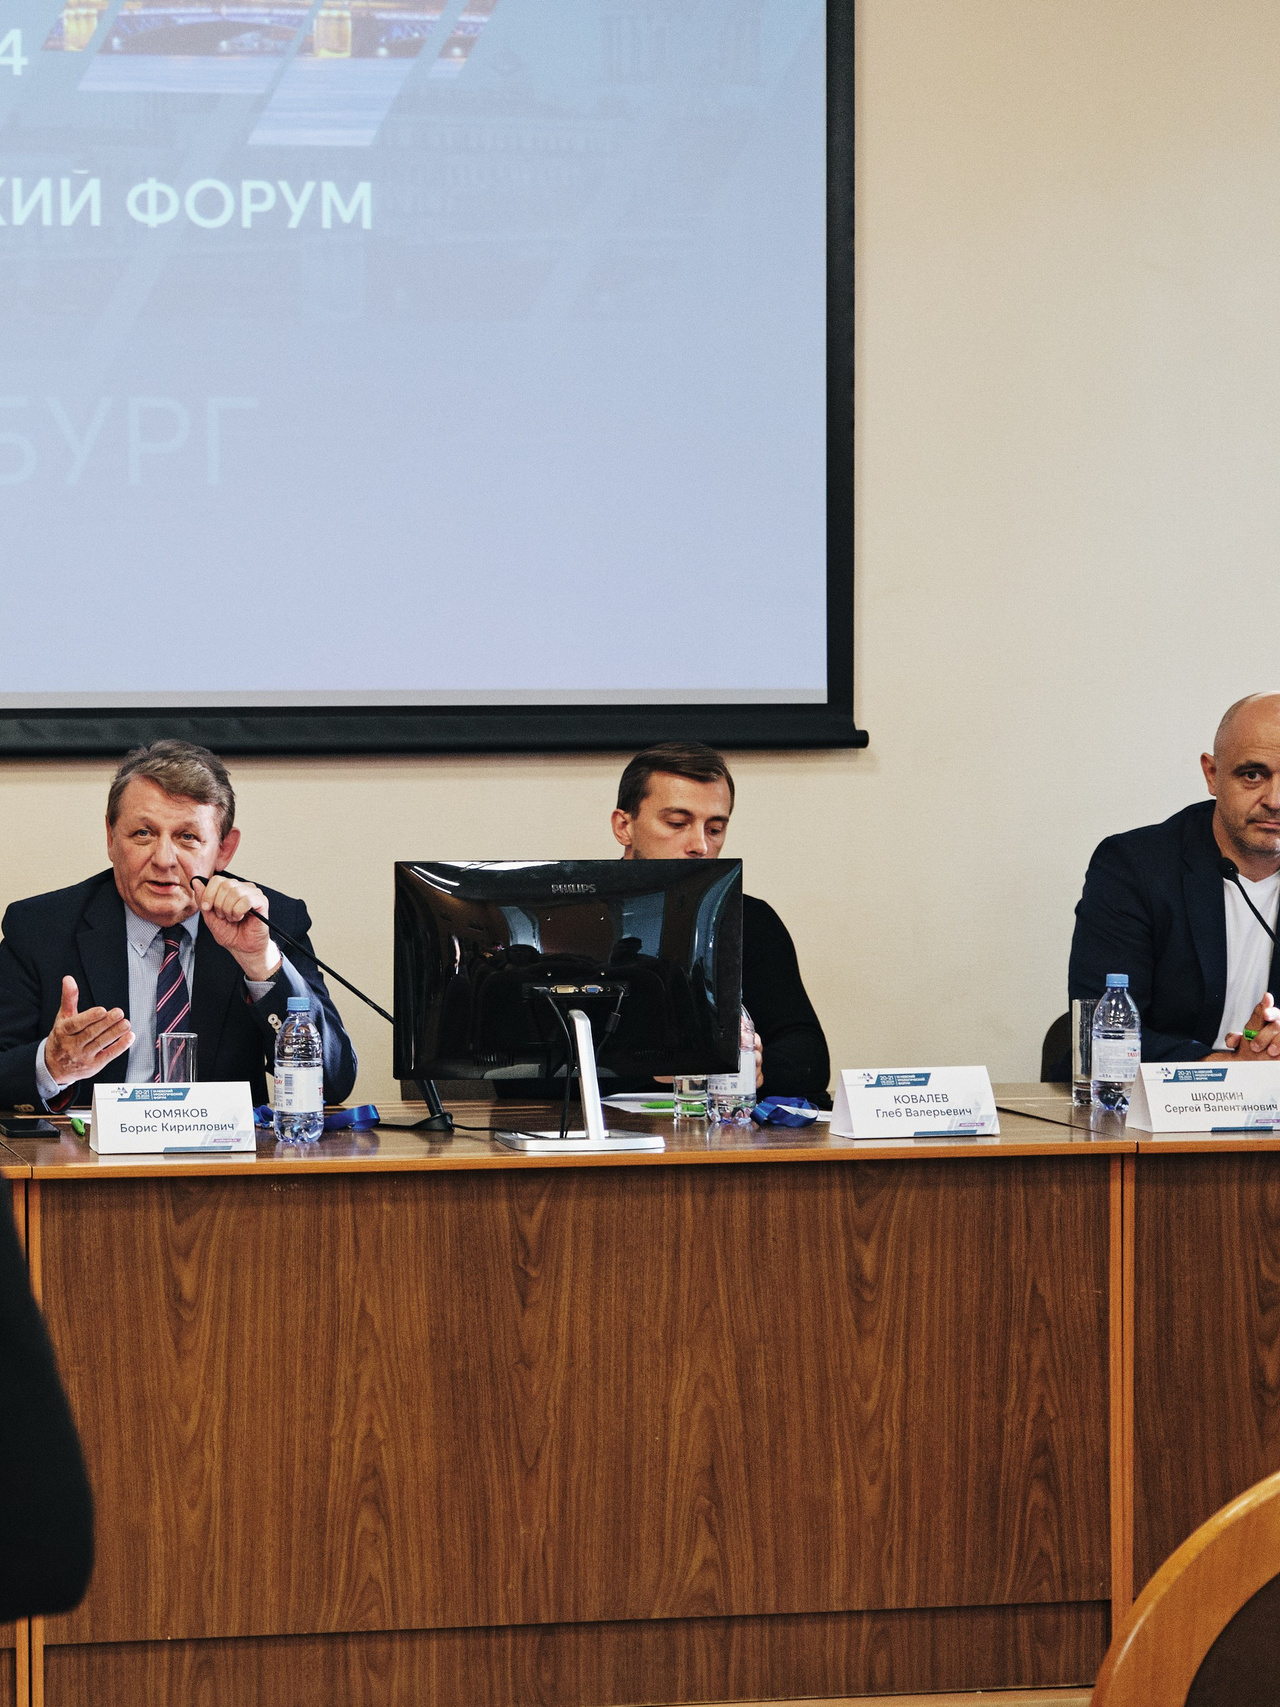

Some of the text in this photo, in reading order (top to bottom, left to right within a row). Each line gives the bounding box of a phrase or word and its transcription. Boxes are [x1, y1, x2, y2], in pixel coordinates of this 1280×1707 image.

[125, 179, 373, 230] ФОРУМ
[551, 883, 597, 894] PHILIPS
[893, 1093, 949, 1104] КОВАЛЕВ
[1190, 1092, 1244, 1102] ШКОДКИН
[144, 1108, 208, 1119] КОМЯКОВ
[875, 1107, 972, 1118] Глеб Валерьевич
[1164, 1103, 1278, 1114] Сергей Валентинович
[120, 1122, 235, 1134] Борис Кириллович
